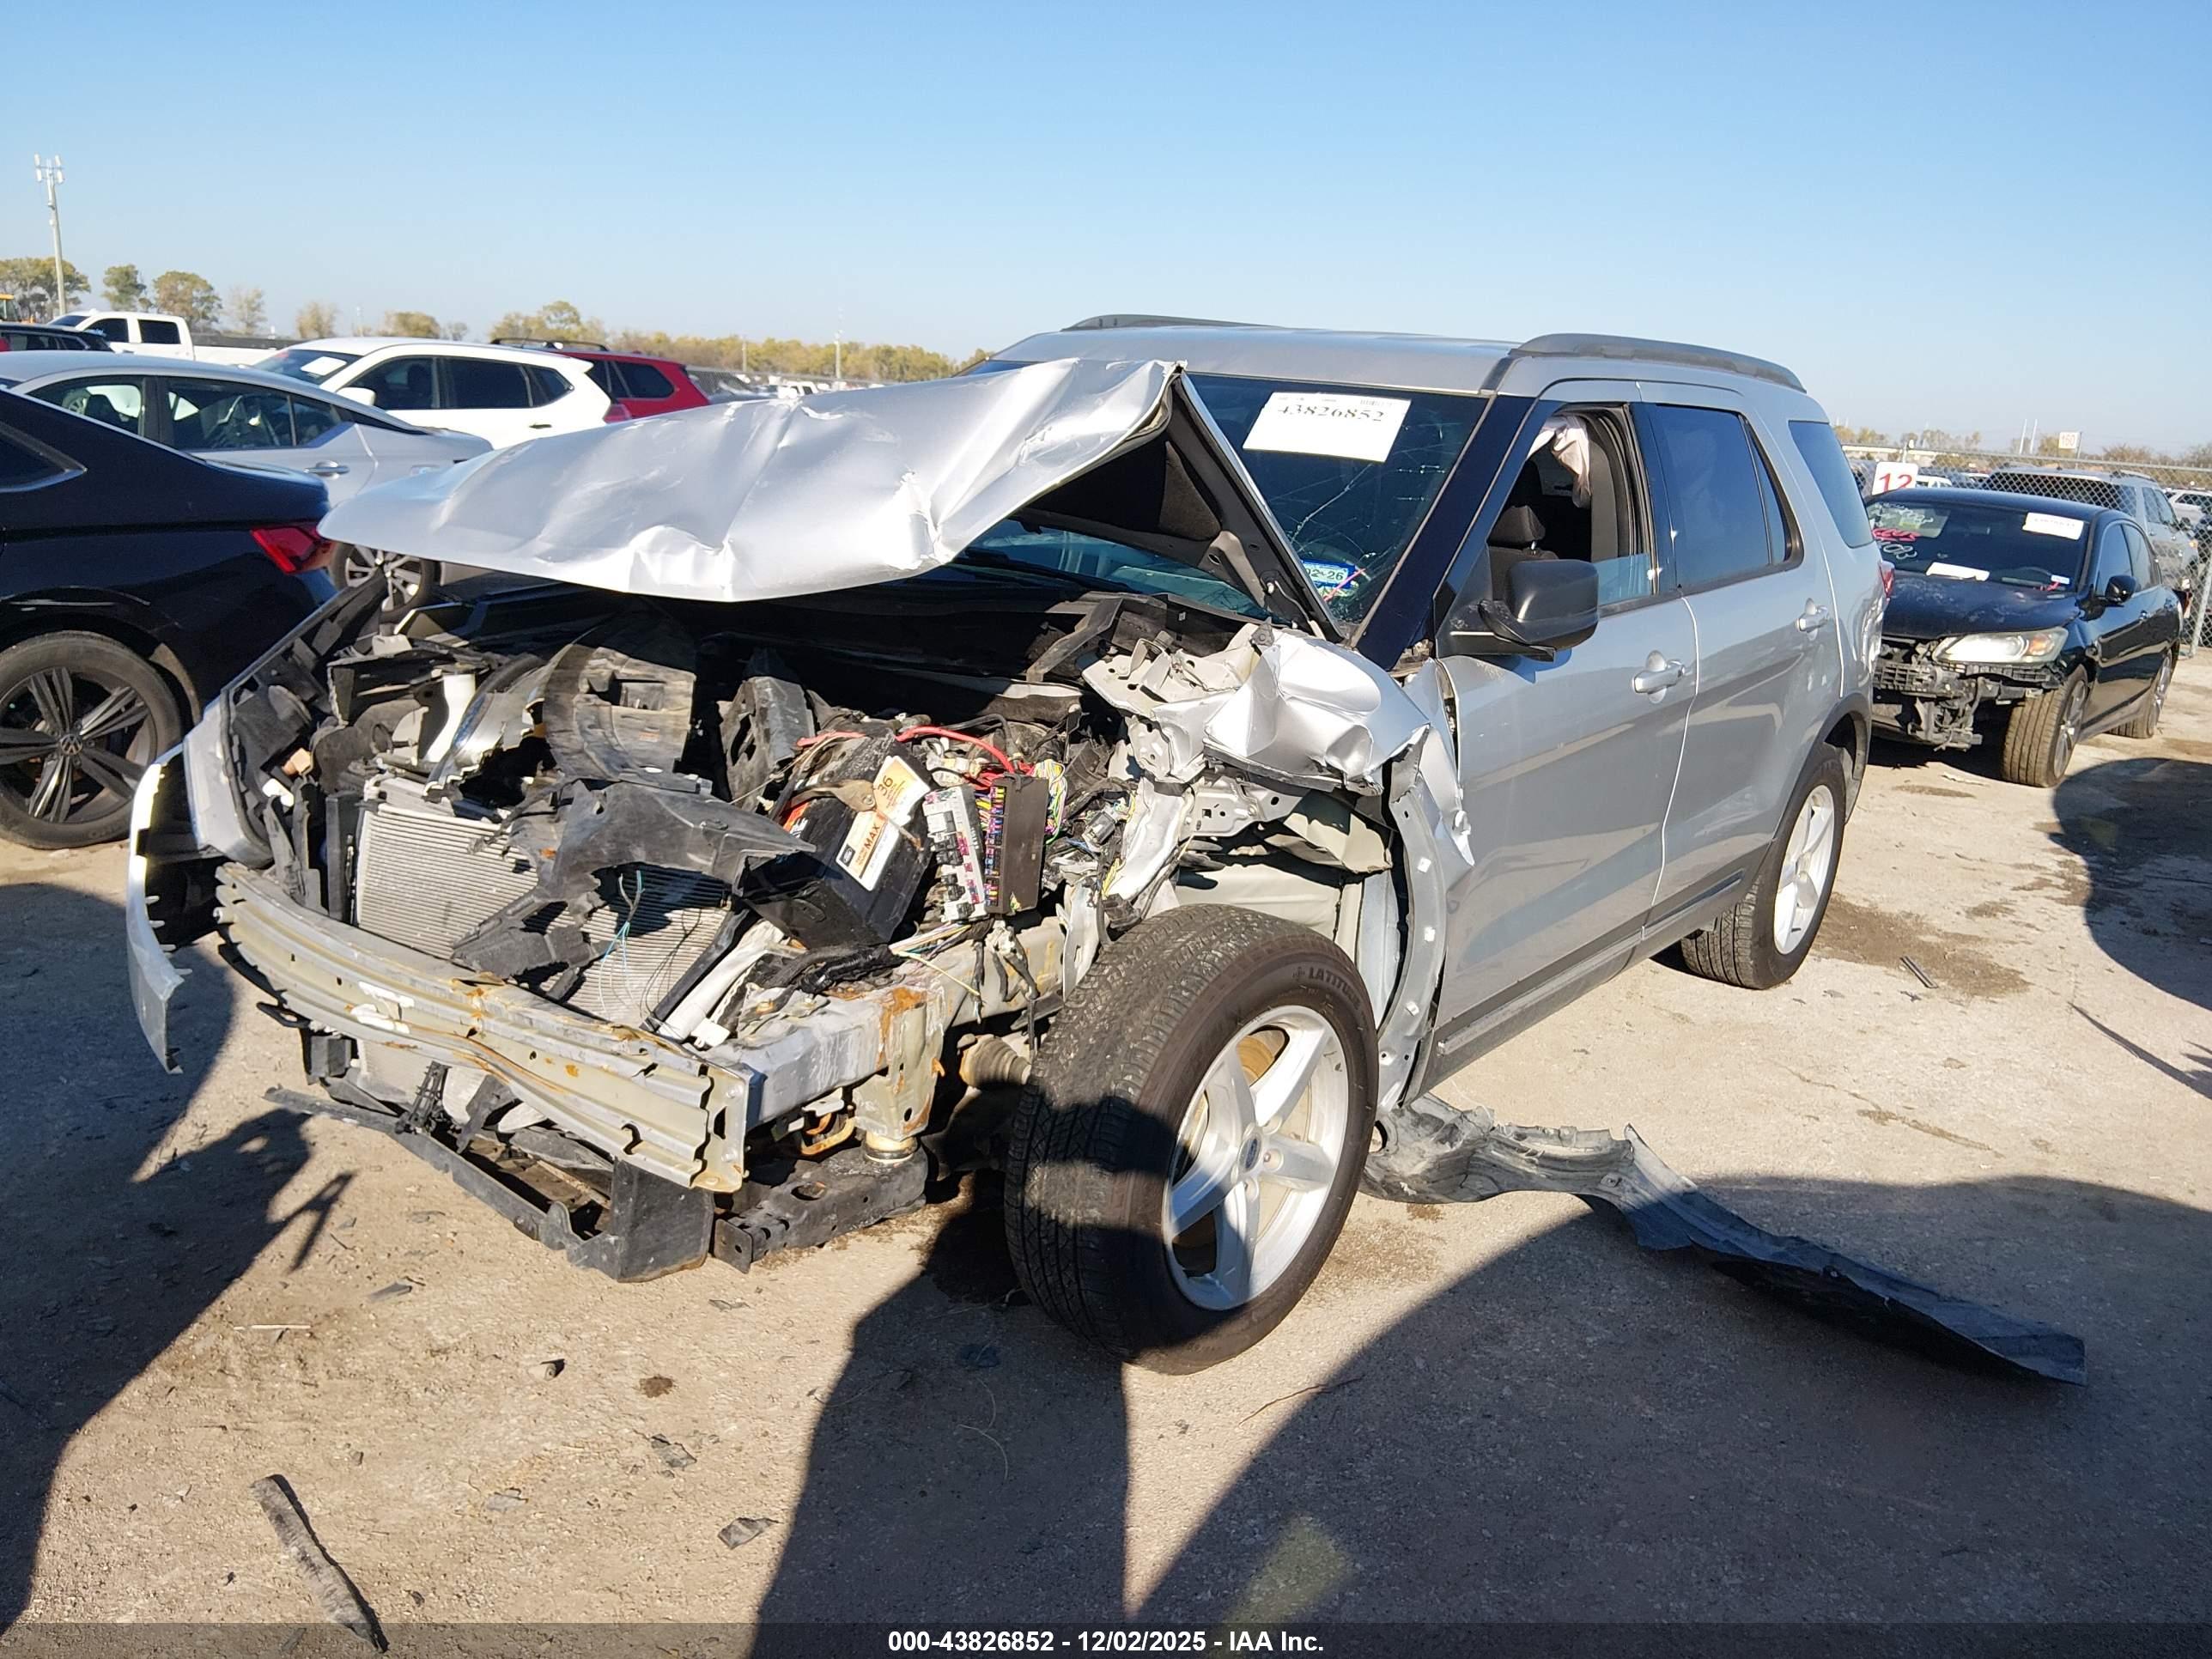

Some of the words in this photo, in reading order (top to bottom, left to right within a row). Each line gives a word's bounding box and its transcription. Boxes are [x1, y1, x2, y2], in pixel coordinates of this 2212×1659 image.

[1278, 404, 1386, 422] 43826852
[1879, 473, 1912, 492] 12
[878, 774, 894, 797] 36
[863, 822, 882, 850] MAX
